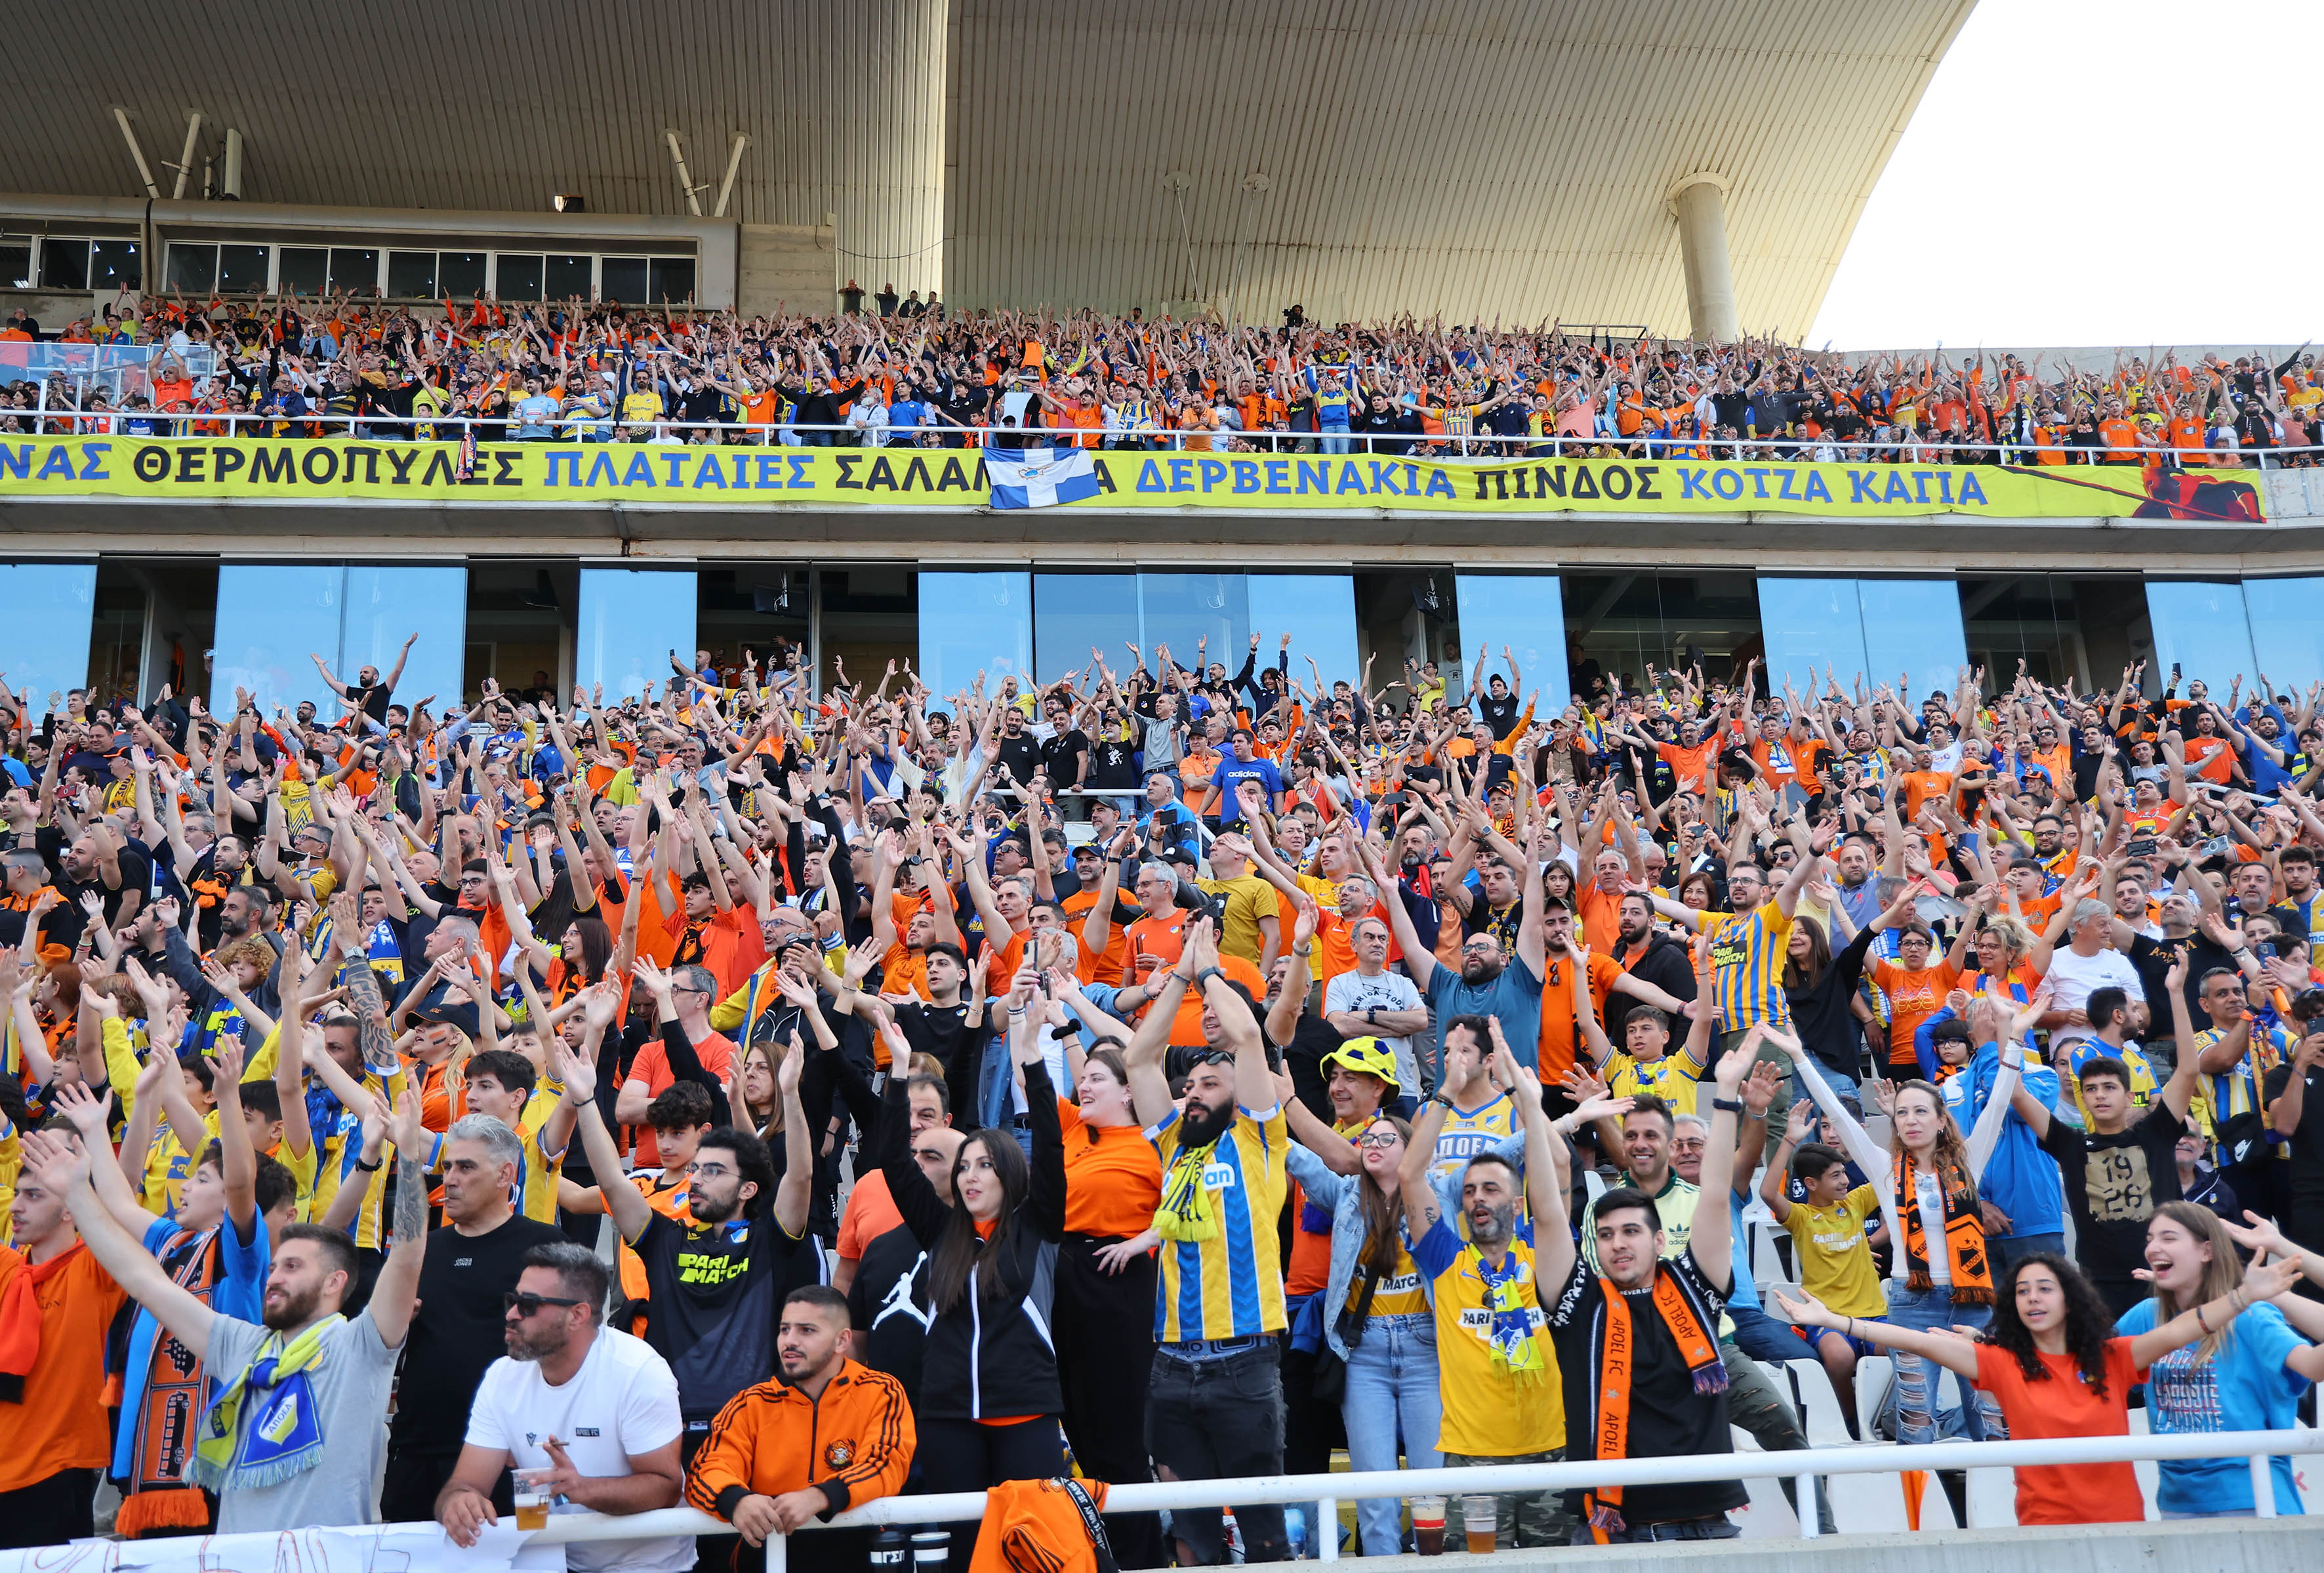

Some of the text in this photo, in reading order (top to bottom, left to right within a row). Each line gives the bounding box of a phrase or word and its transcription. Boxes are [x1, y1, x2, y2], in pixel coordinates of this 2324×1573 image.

[134, 446, 523, 487] ΘΕΡΜΟΠΥΛΕΣ
[544, 451, 815, 490] ΠΛΑΤΑΙΕΣ
[835, 455, 1118, 493] ΣΑΛΑΑ
[1135, 459, 1456, 499] ΔΕΡΒΕΝΑΚΙΑ
[1474, 464, 1663, 500] ΠΙΝΔΟΣ
[1681, 466, 1833, 504] ΚΟΤΖΑ
[1713, 946, 1734, 958] PARI
[1715, 952, 1747, 967] MATCH
[2103, 1154, 2133, 1183] 19
[2104, 1183, 2142, 1214] 26
[678, 1253, 729, 1273] PARI
[680, 1264, 749, 1284] MATCH
[1463, 1311, 1491, 1325] PARI
[1661, 1292, 1697, 1339] APOEL FC
[1604, 1317, 1625, 1454] APOEL FC APOEL
[268, 1404, 293, 1434] ΑΠΟΕΛ
